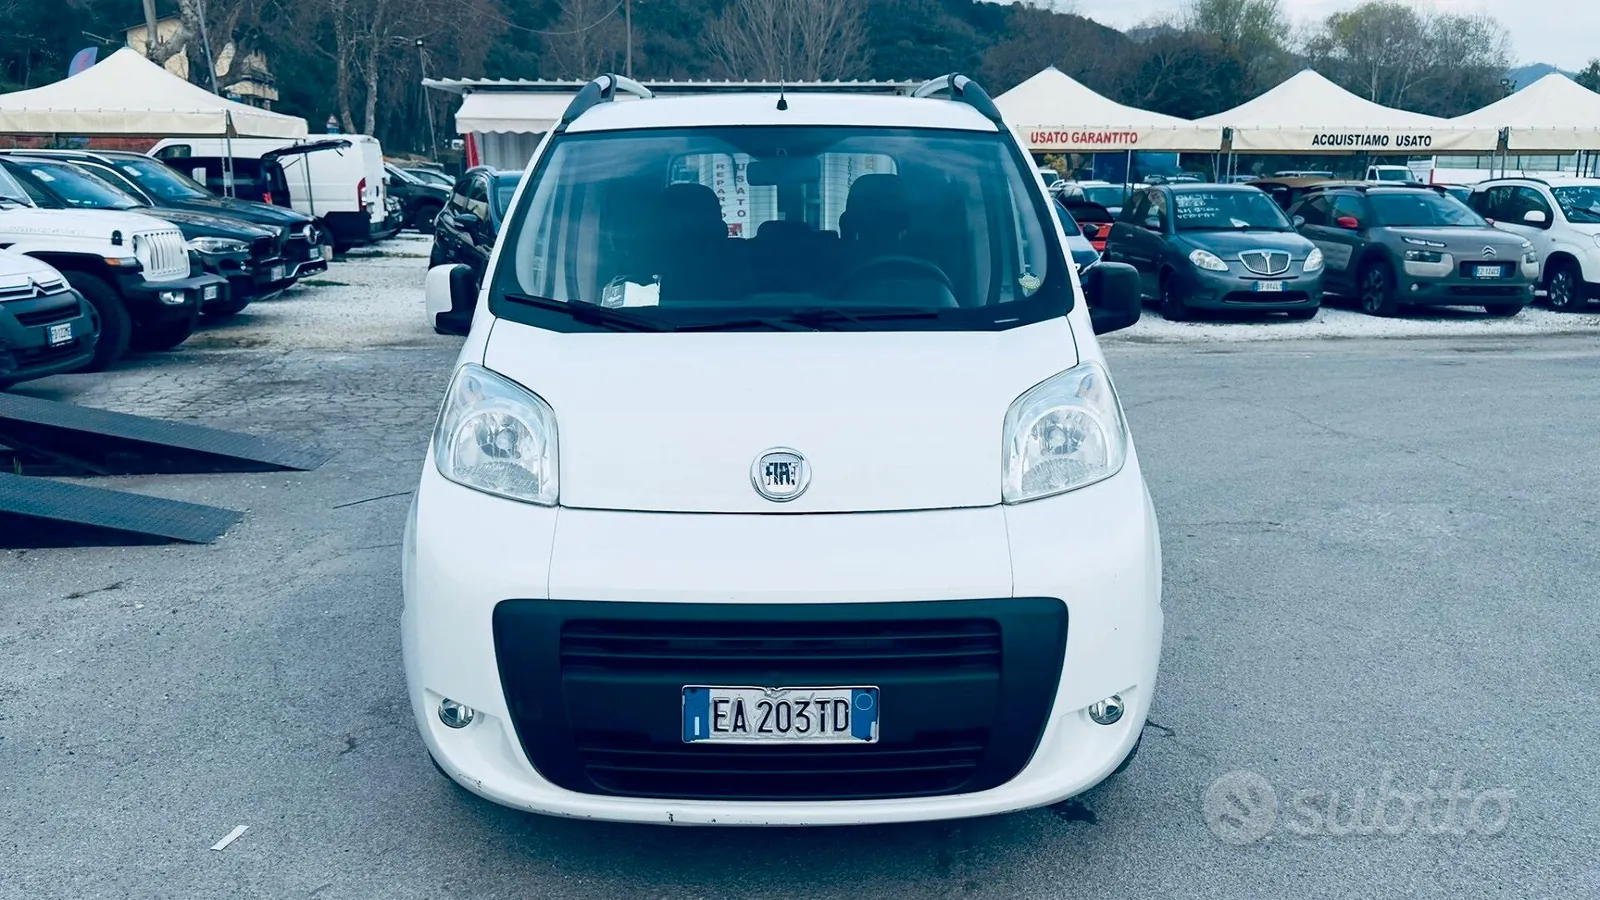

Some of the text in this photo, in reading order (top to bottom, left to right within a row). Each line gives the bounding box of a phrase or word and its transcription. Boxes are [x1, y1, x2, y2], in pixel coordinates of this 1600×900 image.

[1031, 131, 1138, 144] USATO GARANTITO
[1312, 134, 1432, 147] ACQUISTIAMO USATO
[716, 163, 726, 218] REPARO
[736, 163, 746, 217] USATO
[765, 462, 796, 485] FIAT
[713, 698, 747, 733] EA
[757, 698, 849, 733] 203TD
